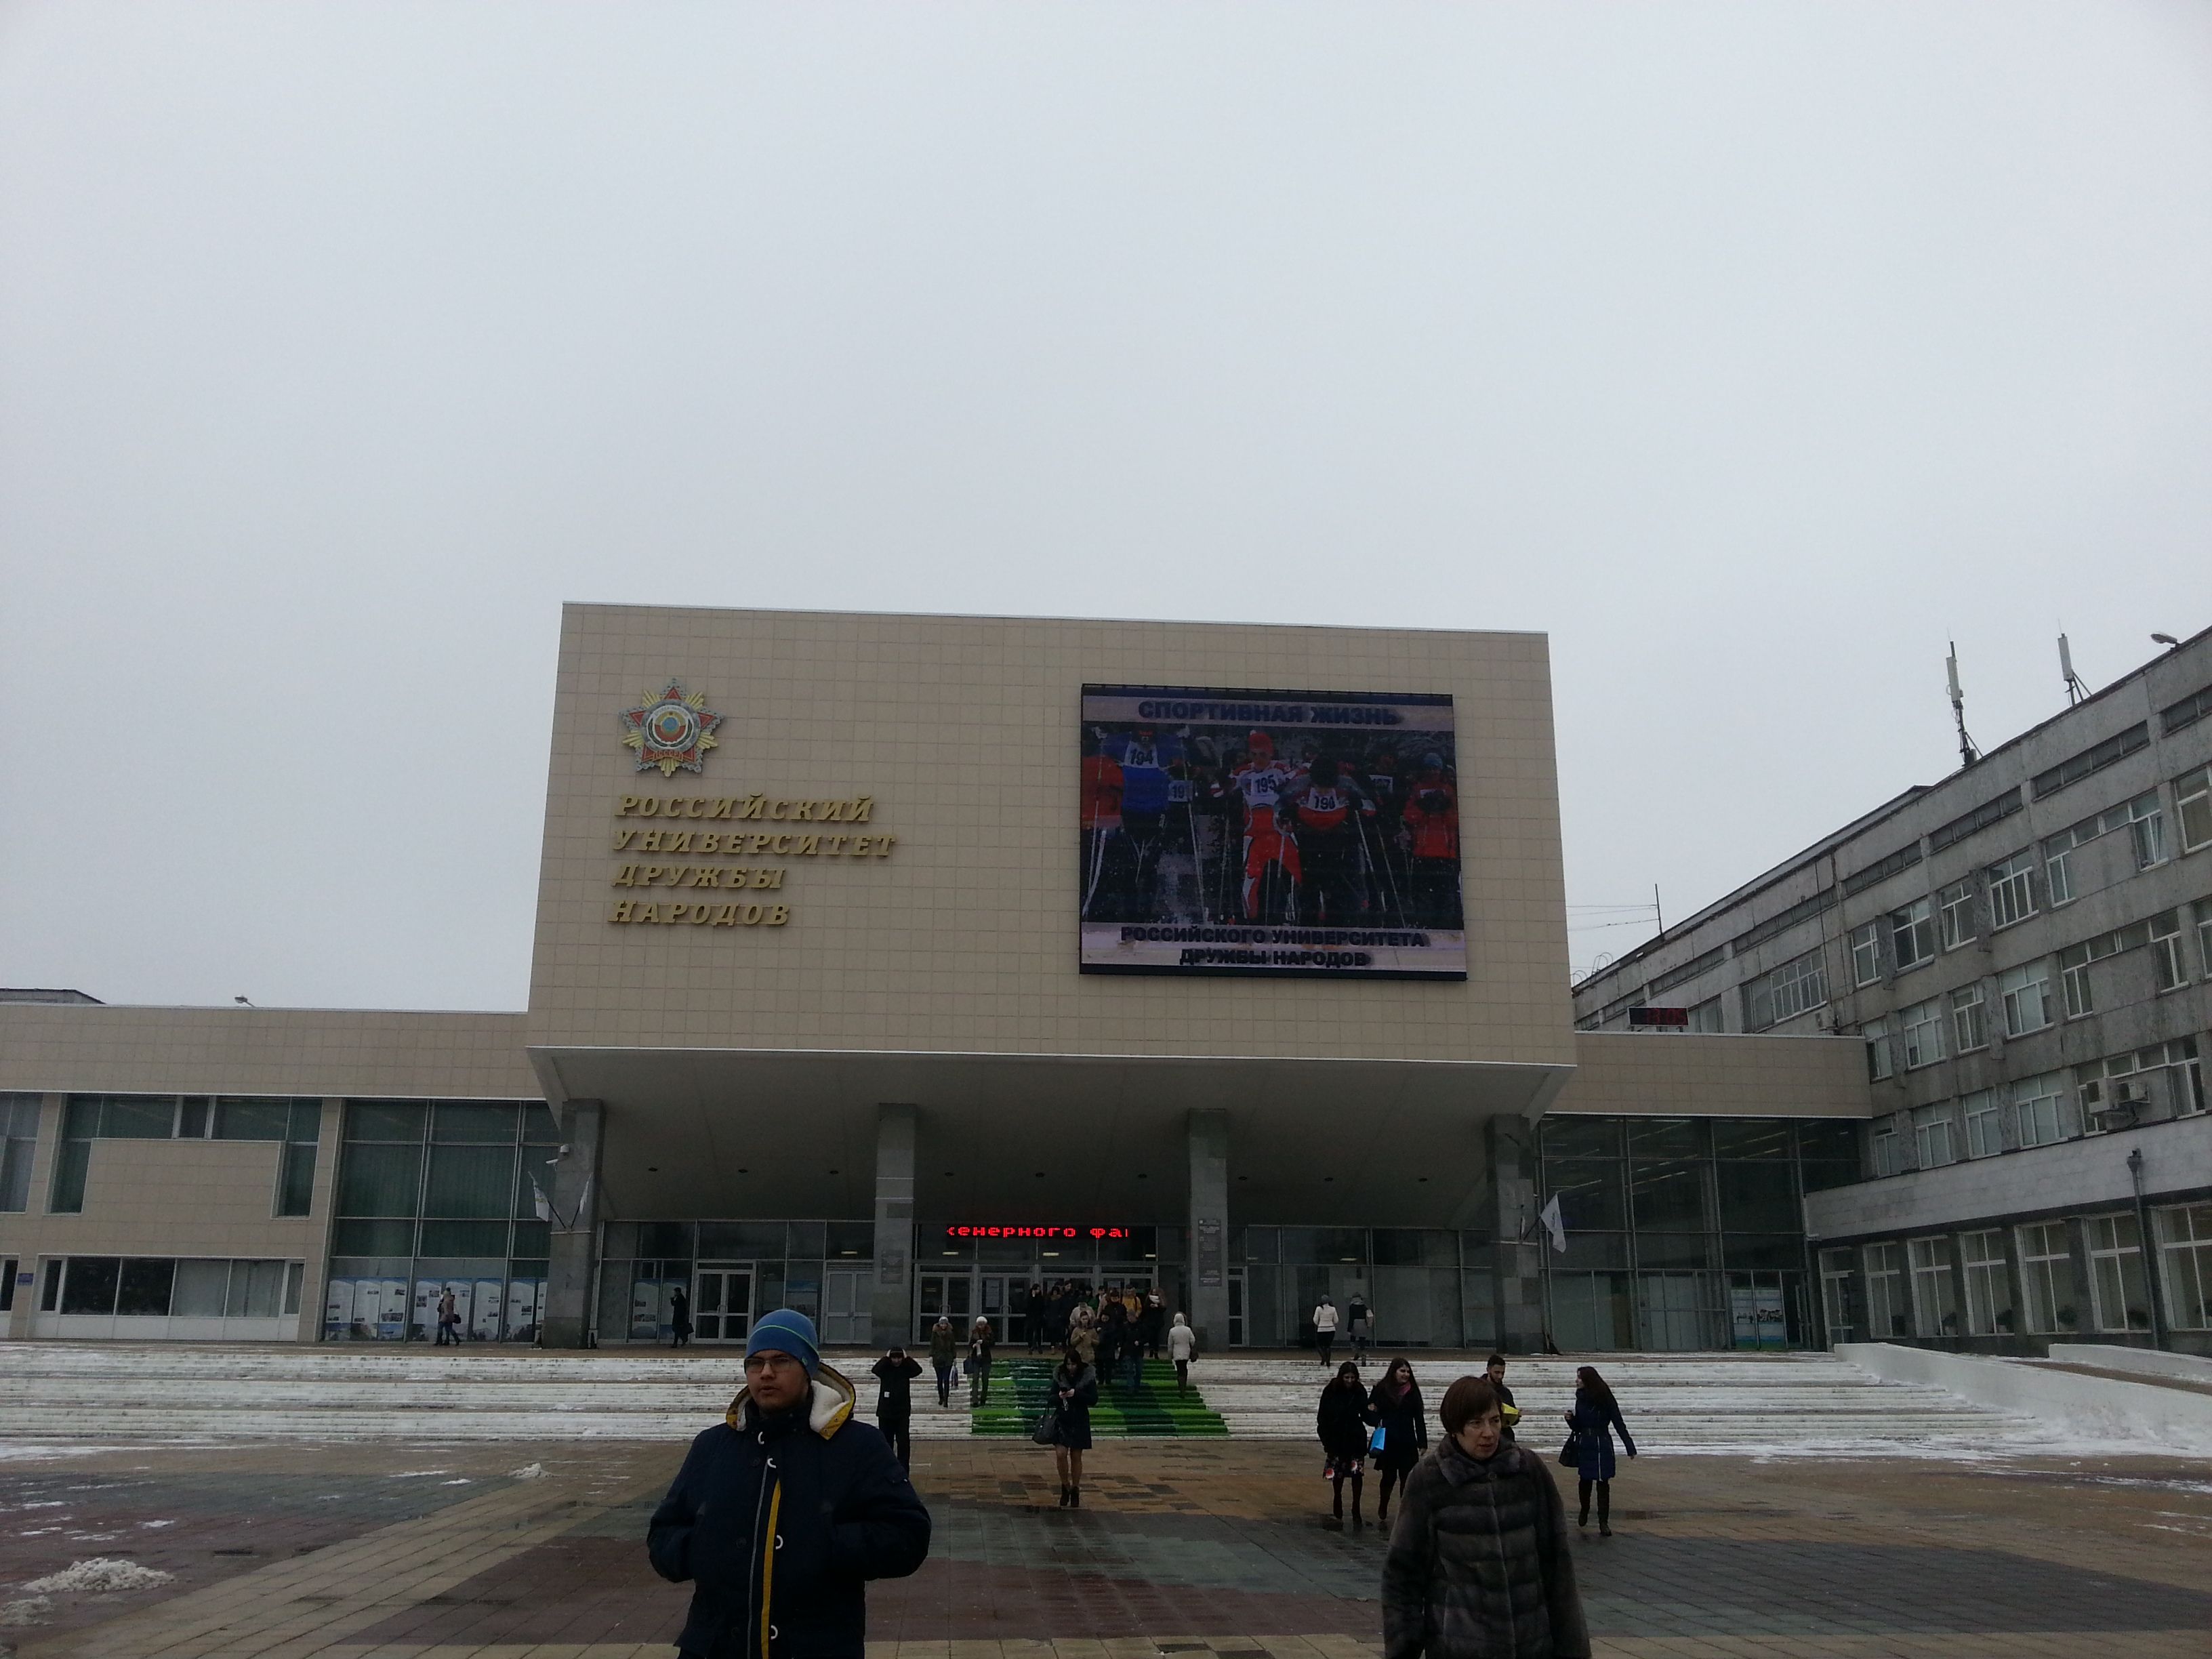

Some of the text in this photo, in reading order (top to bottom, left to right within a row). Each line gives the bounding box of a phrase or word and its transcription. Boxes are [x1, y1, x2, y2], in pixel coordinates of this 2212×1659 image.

[1138, 701, 1401, 725] СПОРТИВНАЯ ЖИЗНЬ
[1255, 774, 1277, 793] 195
[613, 793, 874, 822] РОССИЙСКИЙ
[613, 830, 897, 857] УНИВЕРСИТЕТ
[611, 863, 786, 889] ДРУЖБЫ
[608, 900, 790, 926] НАРОДОВ
[1121, 926, 1426, 947] РОССИЙСКОГО УНИВЕРСИТЕТА
[1179, 949, 1370, 968] ДРУЖБЫ НАРОДОВ
[1090, 1228, 1128, 1239] фа
